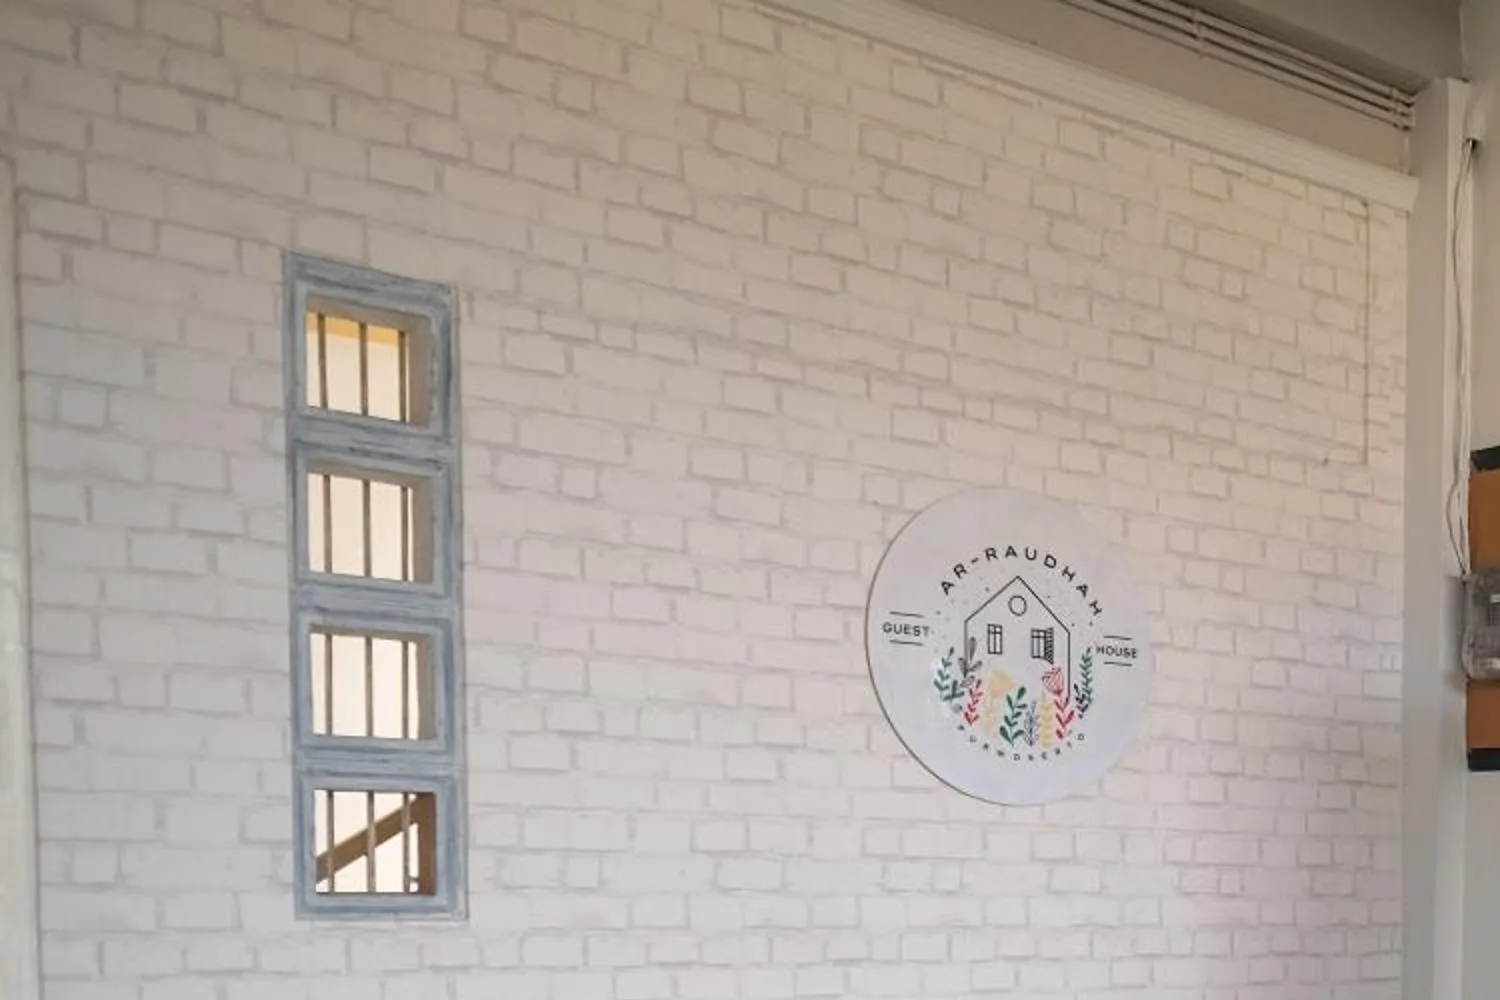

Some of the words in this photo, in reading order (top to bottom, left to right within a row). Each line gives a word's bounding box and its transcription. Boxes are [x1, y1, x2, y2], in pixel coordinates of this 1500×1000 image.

[941, 546, 1102, 616] AR-RAUDHAH
[882, 622, 930, 637] GUEST
[1096, 646, 1138, 659] HOUSE
